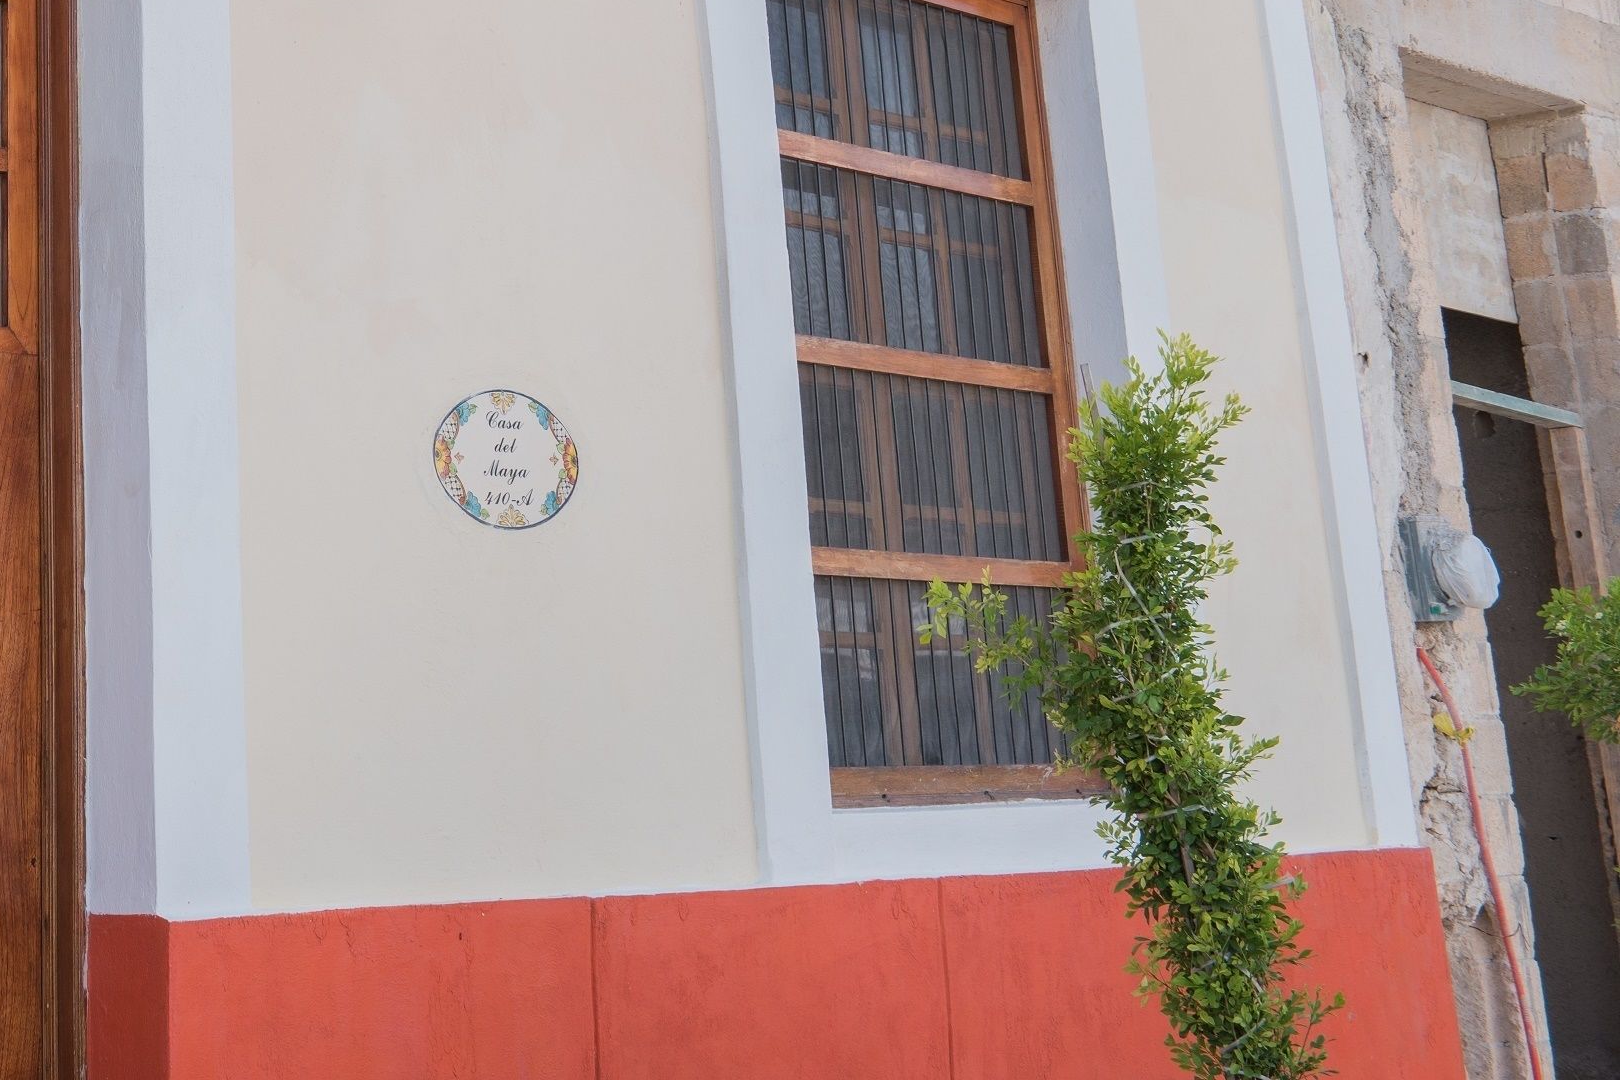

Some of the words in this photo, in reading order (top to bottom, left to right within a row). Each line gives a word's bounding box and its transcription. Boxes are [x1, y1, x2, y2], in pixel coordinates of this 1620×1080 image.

[485, 410, 524, 430] Casa
[494, 437, 518, 454] del
[483, 460, 531, 486] Maya
[484, 488, 534, 507] 410-A
